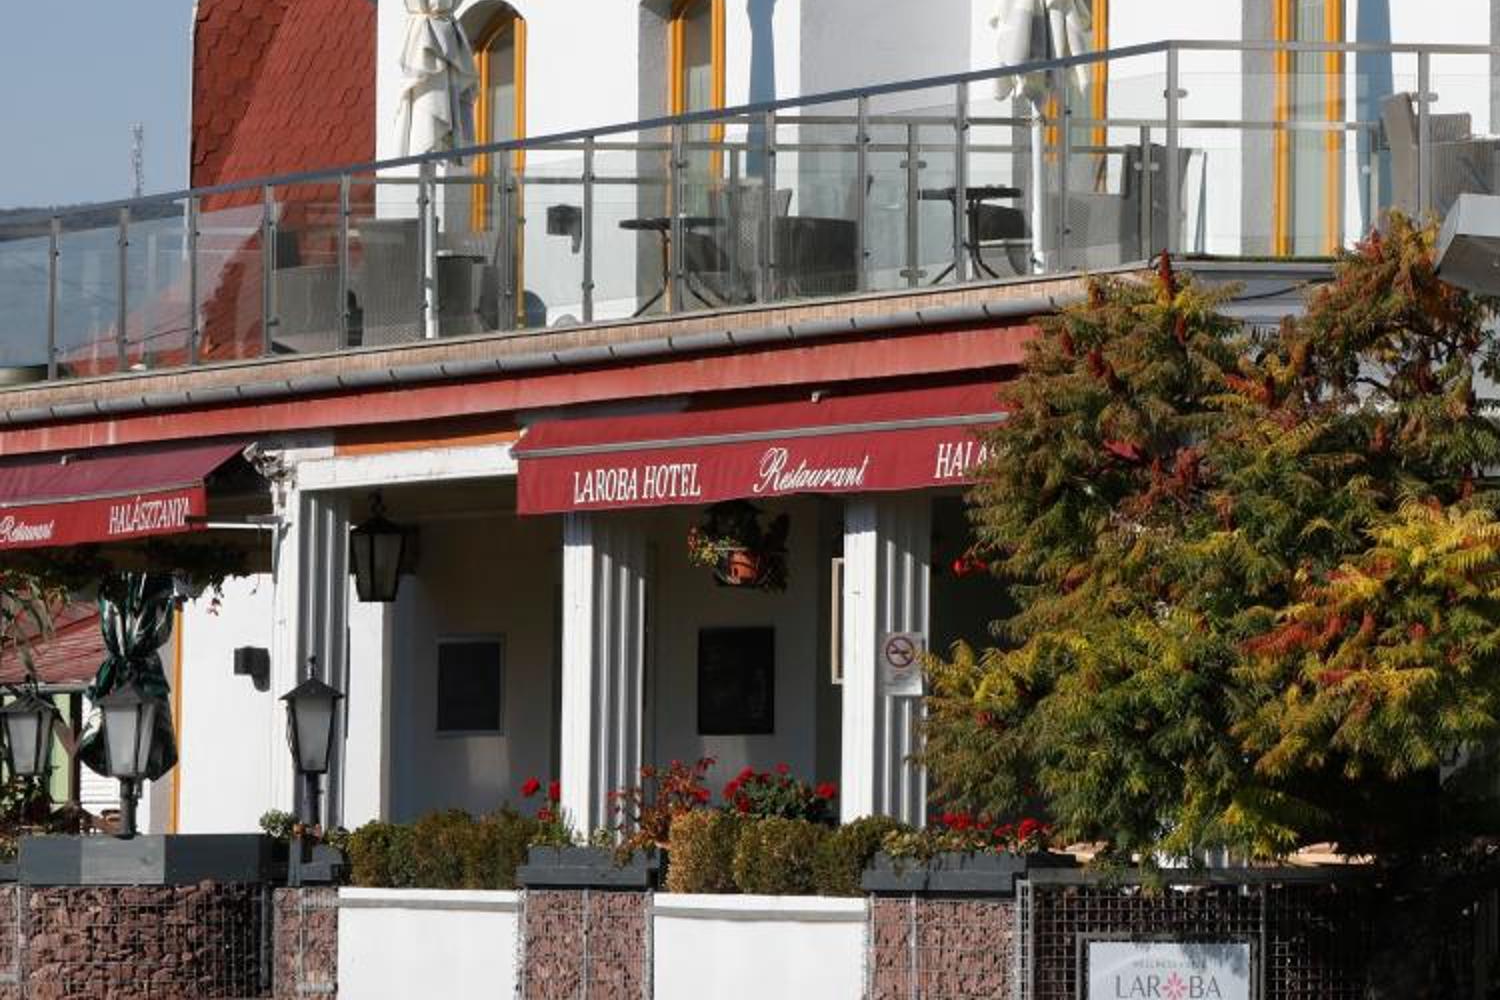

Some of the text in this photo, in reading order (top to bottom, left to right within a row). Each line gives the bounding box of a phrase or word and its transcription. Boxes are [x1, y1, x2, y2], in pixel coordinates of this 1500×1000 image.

[573, 463, 701, 504] LAROBA HOTEL
[753, 447, 869, 493] Restaurant
